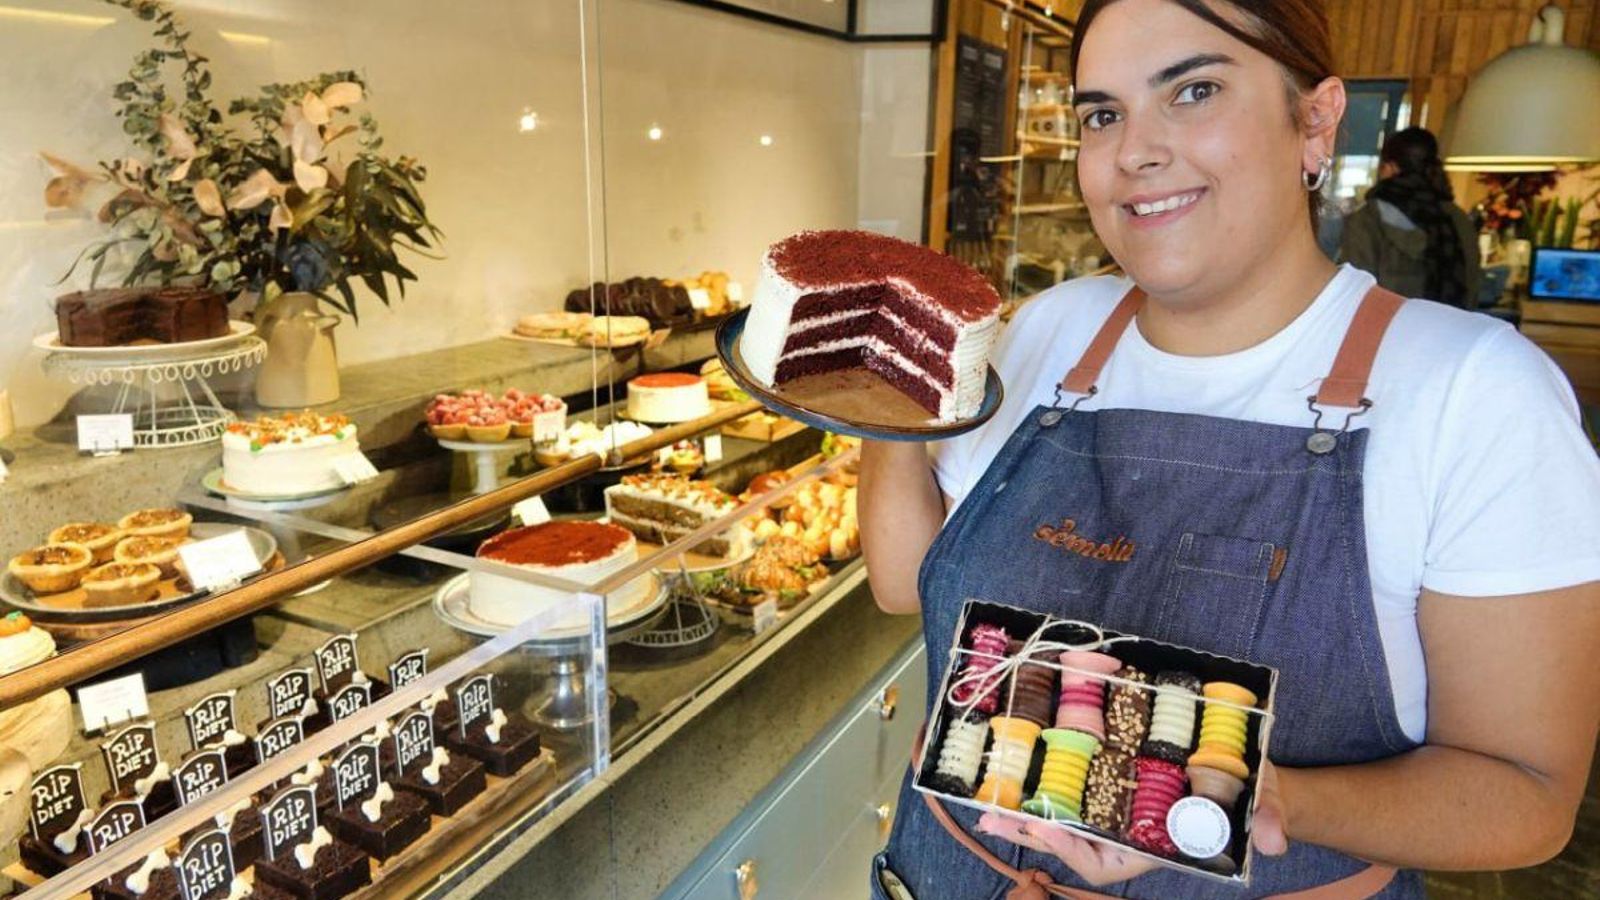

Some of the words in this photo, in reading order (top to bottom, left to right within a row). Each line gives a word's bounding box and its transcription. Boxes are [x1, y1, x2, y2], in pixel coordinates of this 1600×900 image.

[323, 658, 352, 680] DIET
[276, 693, 305, 716] DIET
[463, 700, 490, 726] DIET
[196, 720, 229, 742] DIET
[116, 749, 153, 778] DIET
[401, 739, 430, 766] DIET
[342, 774, 371, 801] DIET
[36, 796, 74, 825] DIET
[273, 815, 311, 847] DIET
[190, 869, 226, 900] DIET
